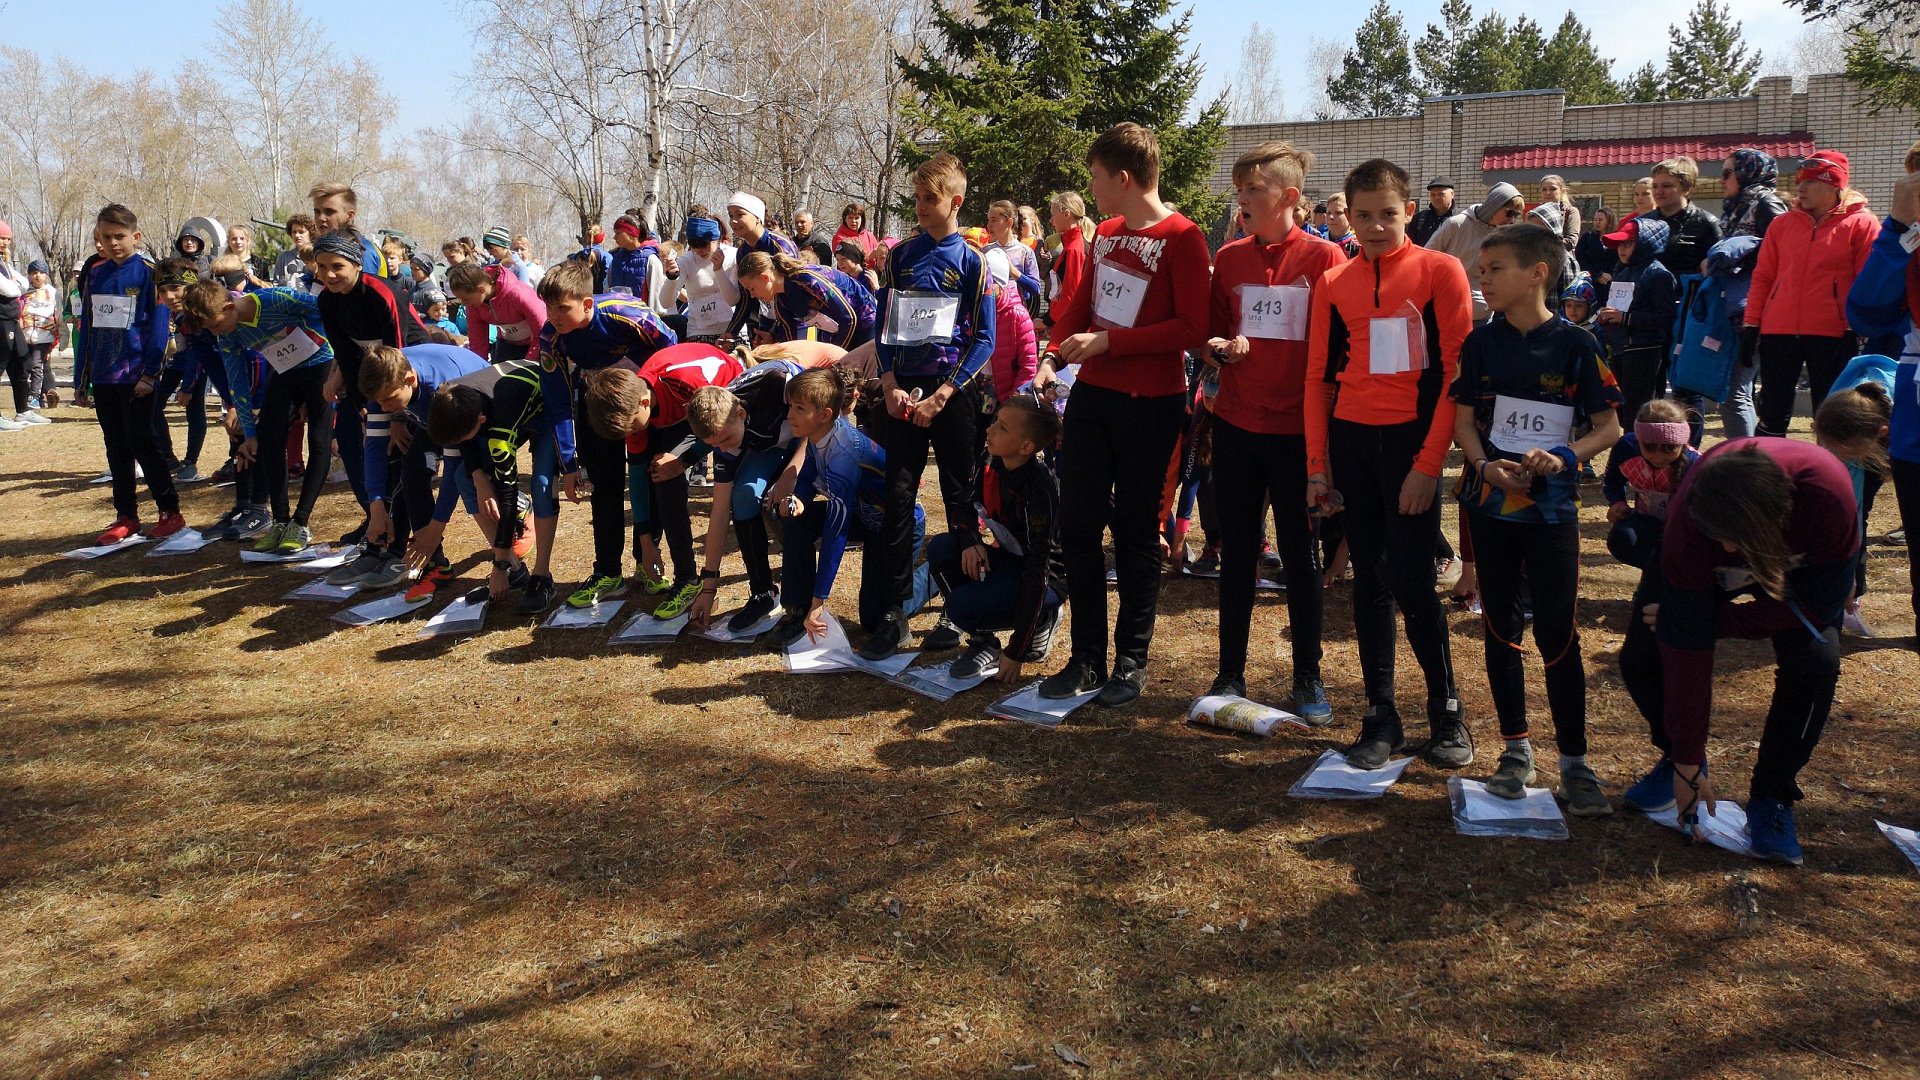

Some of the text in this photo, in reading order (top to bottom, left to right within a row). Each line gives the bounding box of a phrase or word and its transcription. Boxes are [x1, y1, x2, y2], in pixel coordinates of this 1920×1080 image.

[99, 304, 114, 314] 420
[701, 302, 716, 313] 447
[1252, 300, 1282, 315] 413
[911, 309, 936, 320] 405
[277, 343, 298, 358] 412
[1506, 411, 1545, 432] 416
